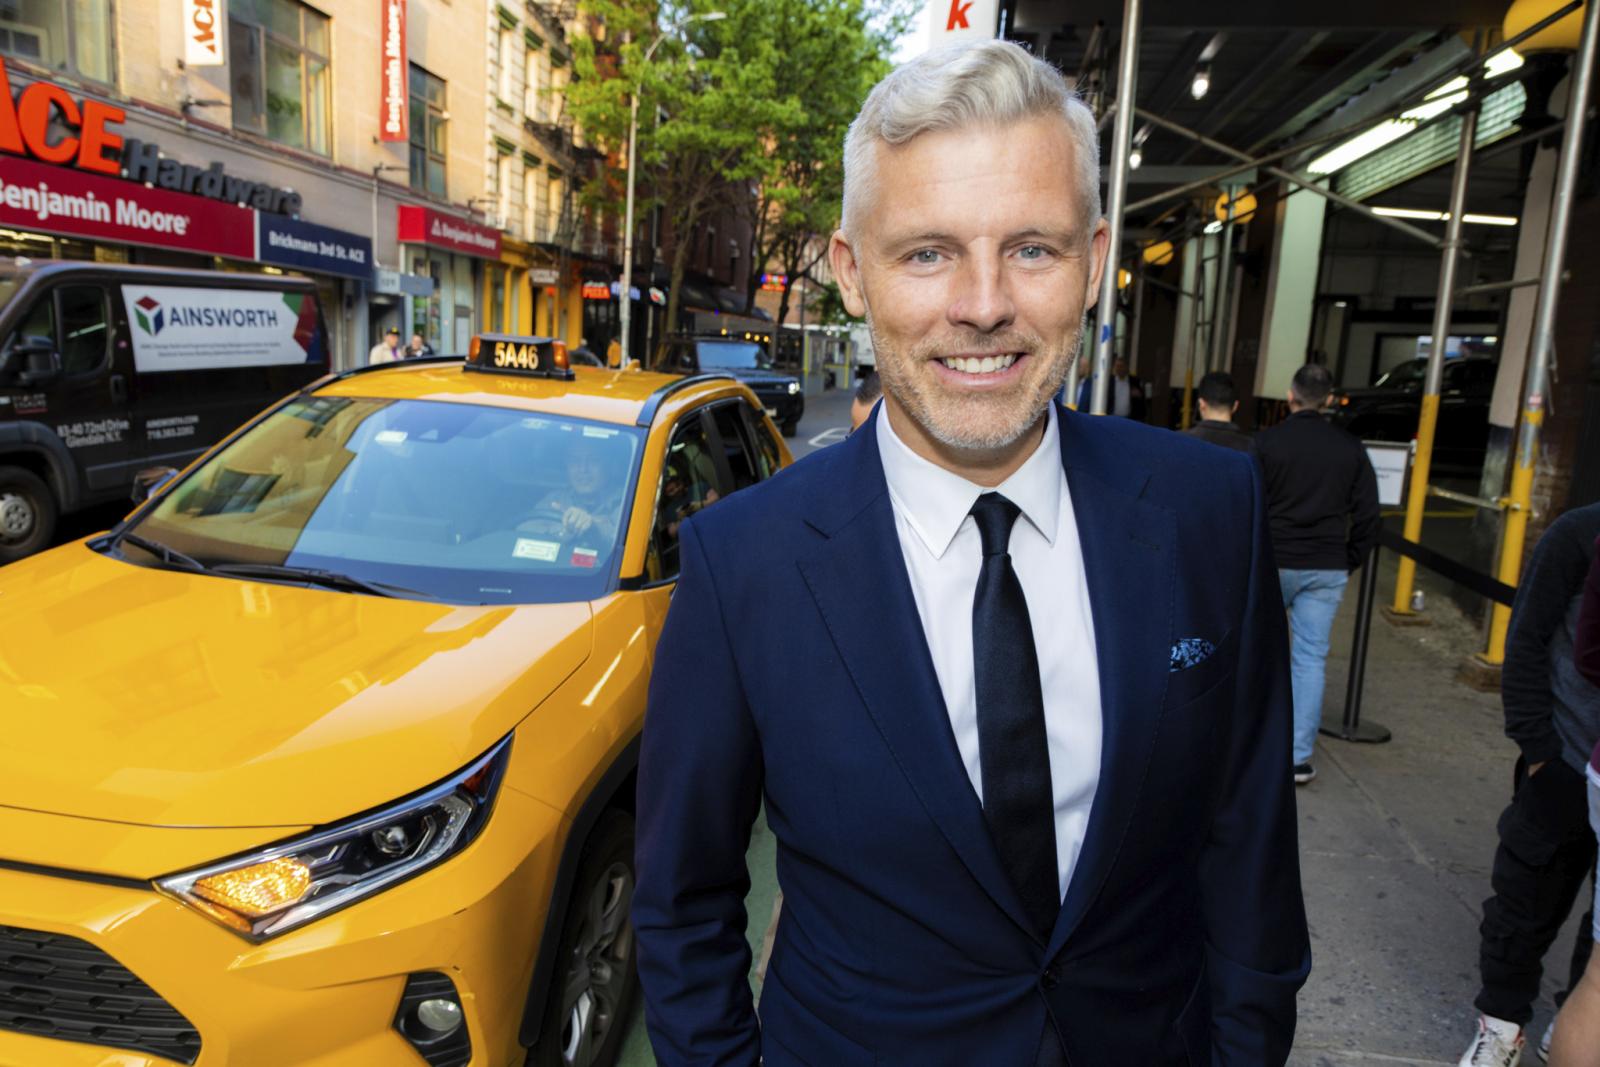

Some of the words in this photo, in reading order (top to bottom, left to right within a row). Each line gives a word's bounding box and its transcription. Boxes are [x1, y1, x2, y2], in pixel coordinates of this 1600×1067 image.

[386, 60, 403, 132] Benjamin
[124, 138, 303, 216] Hardware
[0, 178, 111, 220] enjamin
[269, 230, 318, 254] Brickmans
[348, 247, 365, 264] ACE
[169, 306, 279, 328] AINSWORTH
[494, 341, 539, 370] 5A46
